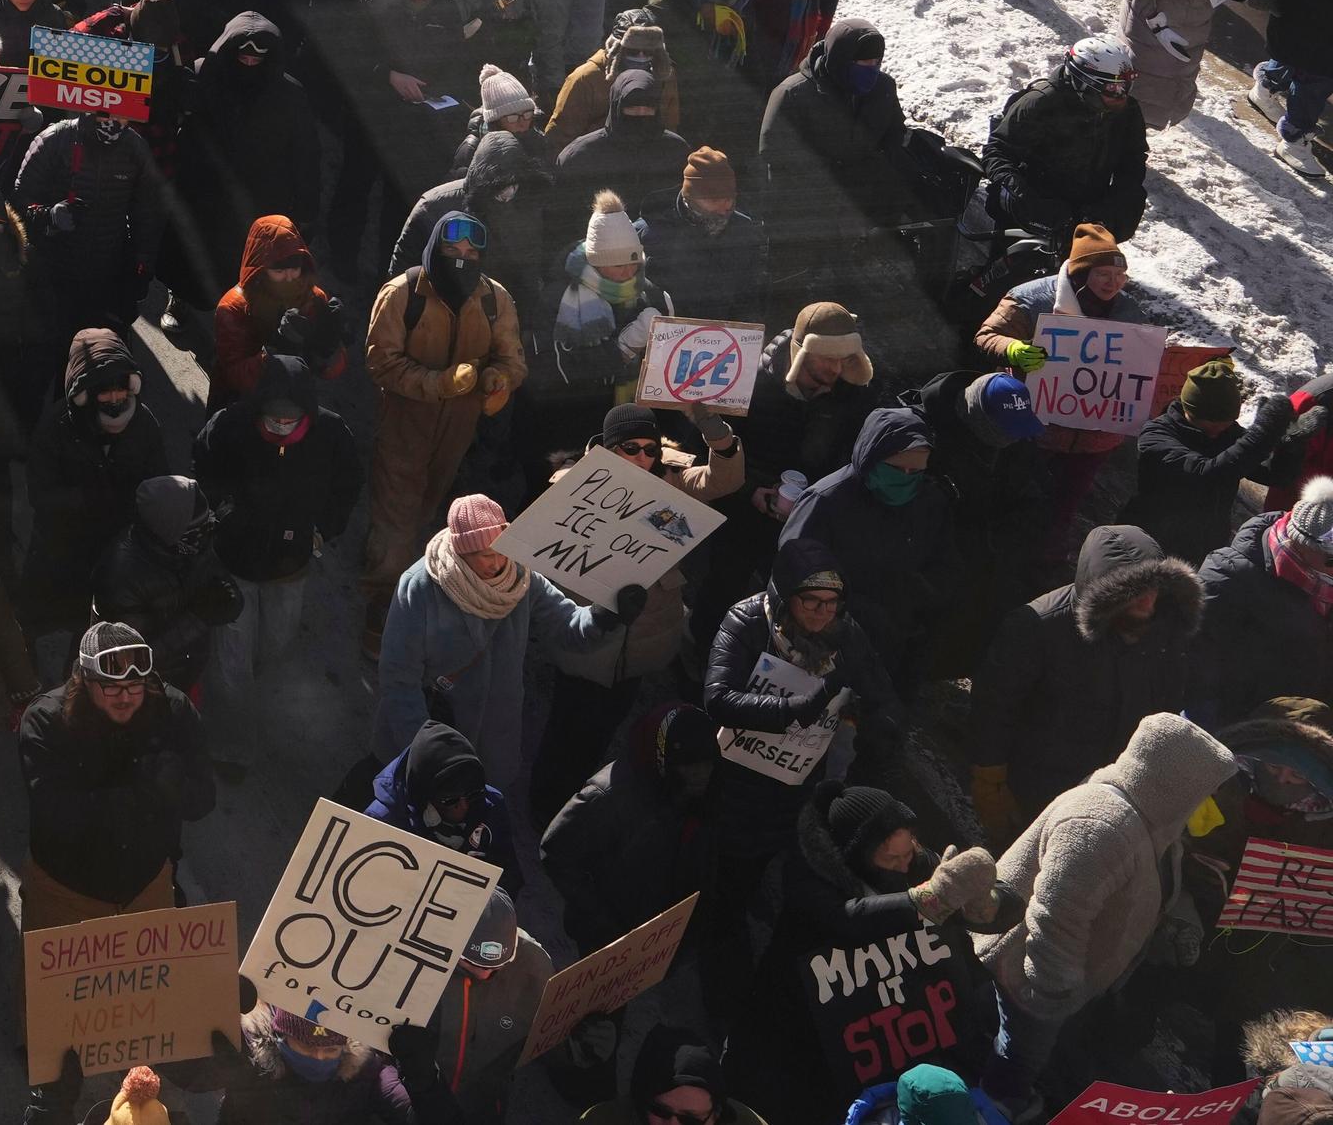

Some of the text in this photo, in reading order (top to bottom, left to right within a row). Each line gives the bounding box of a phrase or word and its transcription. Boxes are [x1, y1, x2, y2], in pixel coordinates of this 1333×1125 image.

[1040, 328, 1124, 365] ICE
[1073, 367, 1153, 401] OUT
[570, 468, 655, 521] PLOW
[533, 540, 614, 577] MN
[554, 506, 668, 564] ICE OUT
[295, 816, 491, 958] ICE
[39, 916, 227, 972] SHAME ON YOU
[275, 912, 447, 1009] OUT
[810, 921, 951, 1005] MAKE
[877, 978, 906, 1007] IT
[843, 979, 958, 1083] STOP
